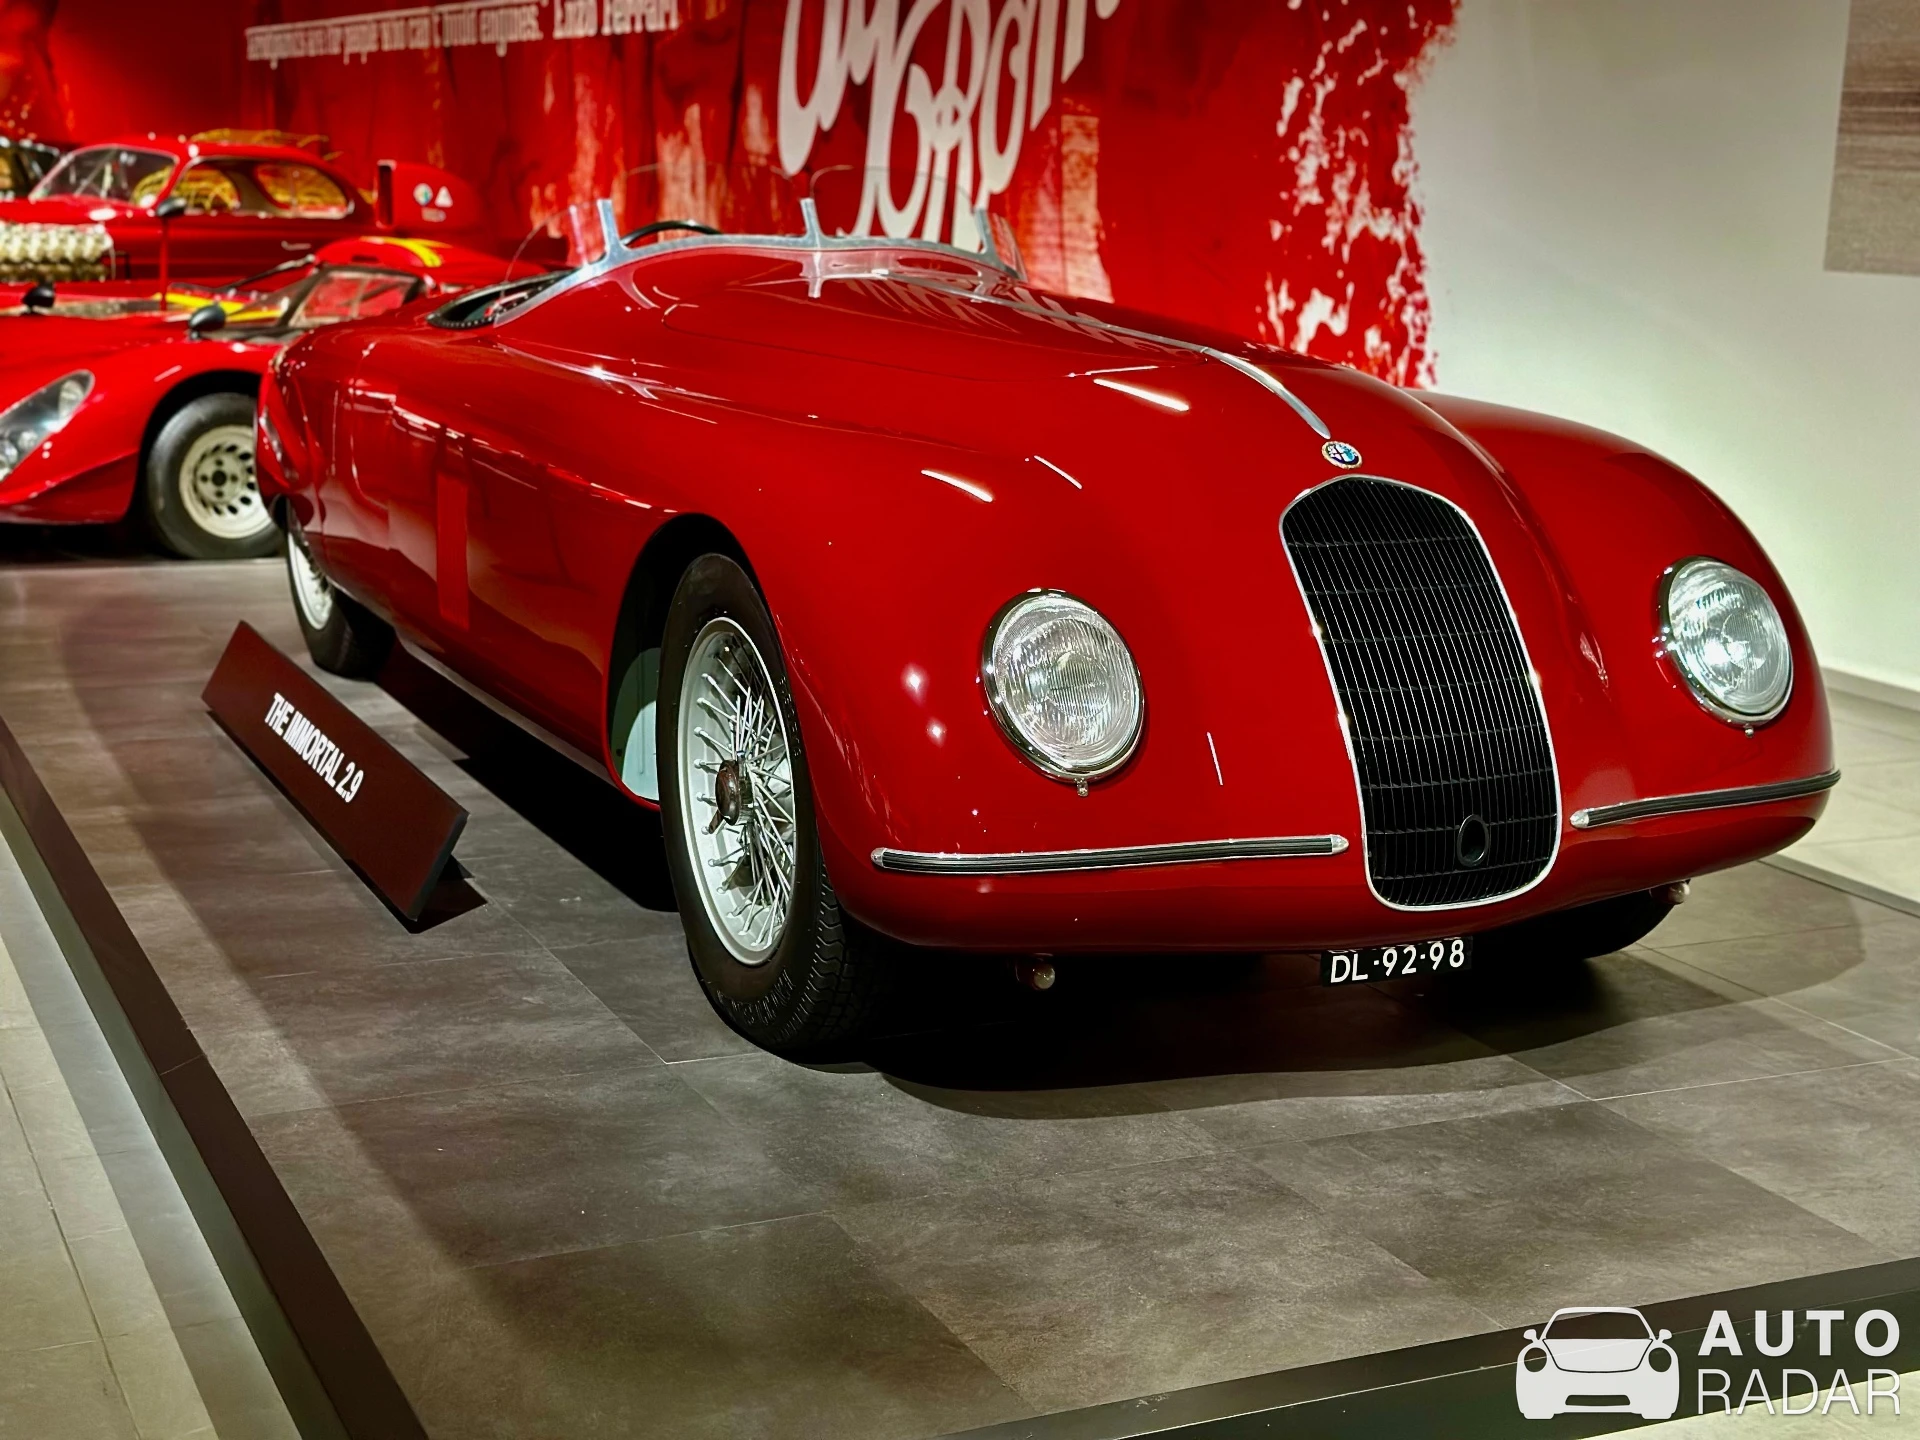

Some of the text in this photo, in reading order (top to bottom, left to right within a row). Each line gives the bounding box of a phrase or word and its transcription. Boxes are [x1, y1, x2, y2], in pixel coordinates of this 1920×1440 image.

[265, 692, 364, 803] THE IMMORTAL 2.9
